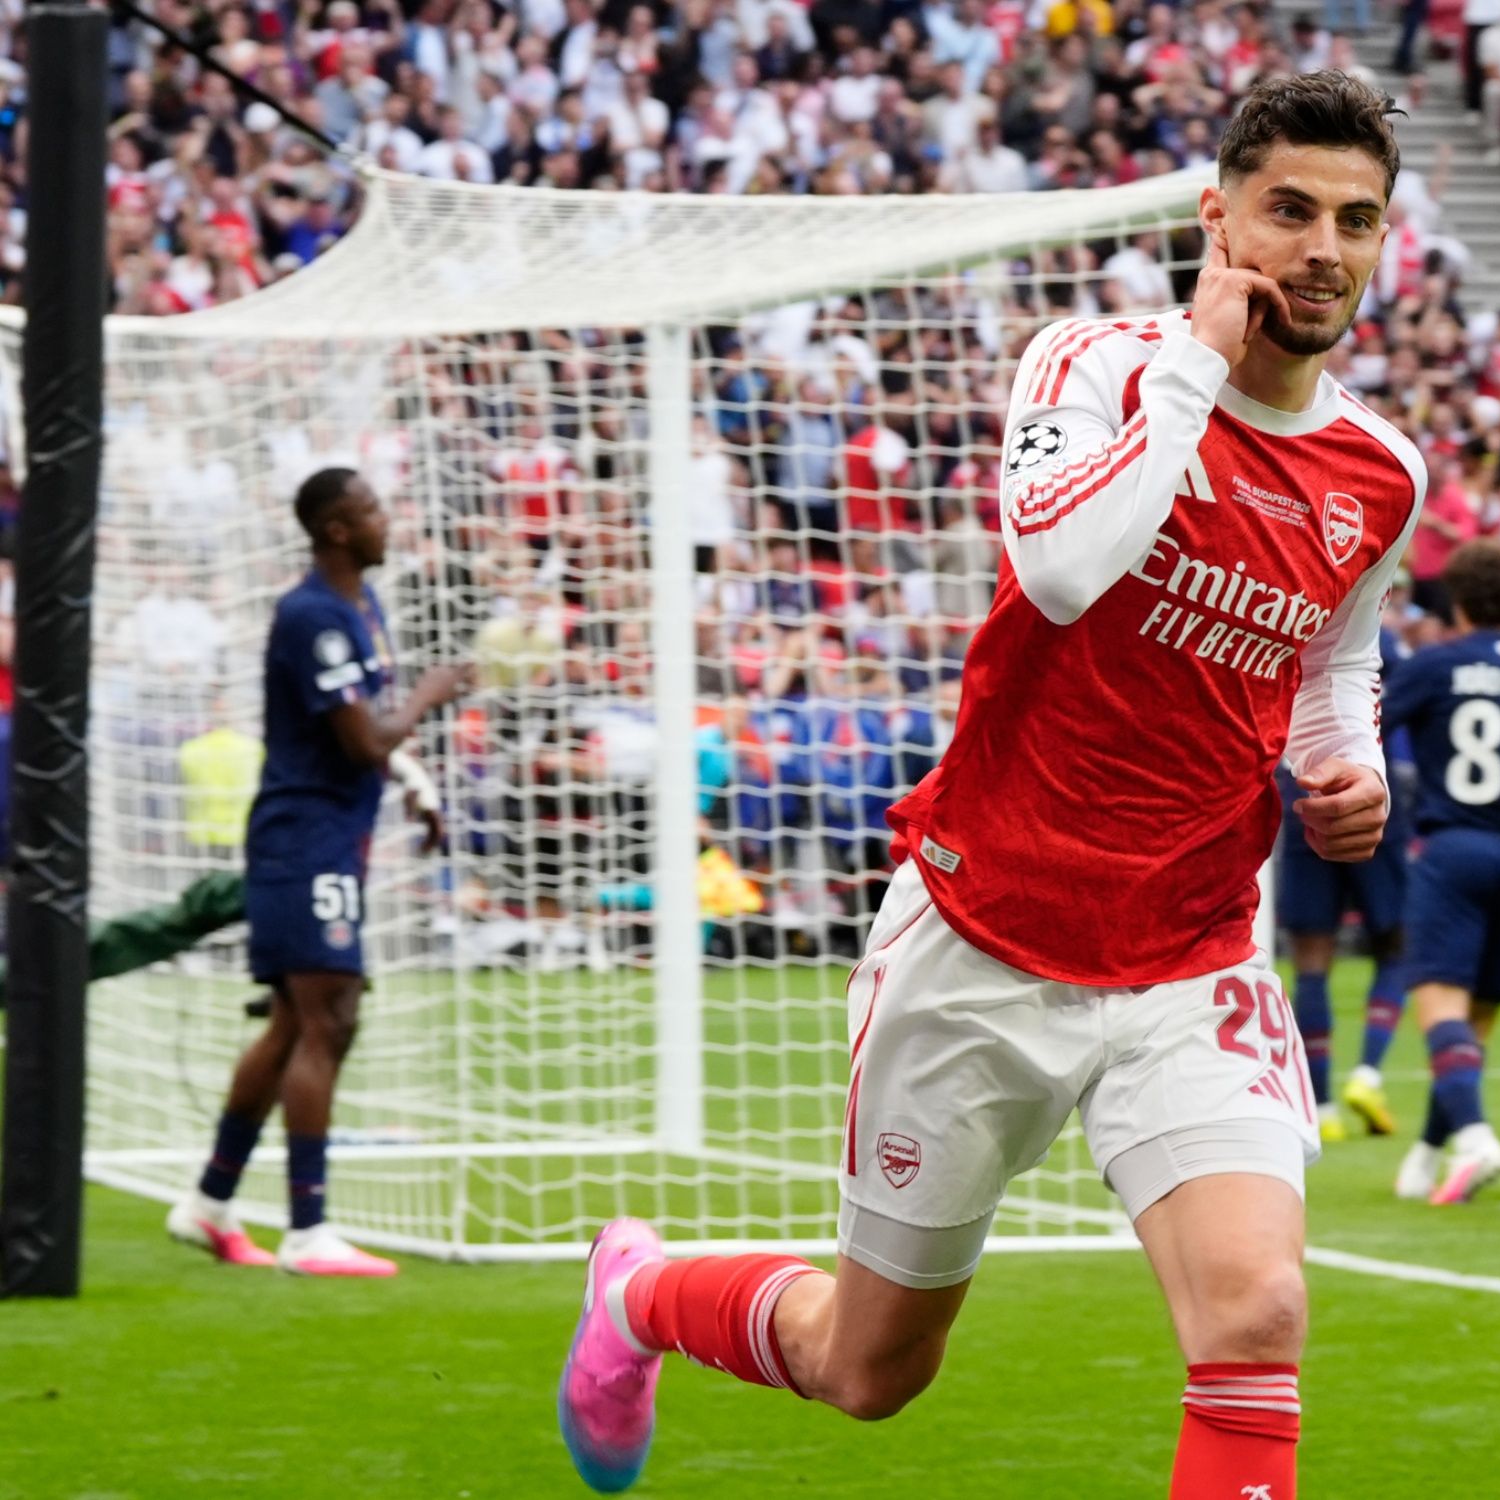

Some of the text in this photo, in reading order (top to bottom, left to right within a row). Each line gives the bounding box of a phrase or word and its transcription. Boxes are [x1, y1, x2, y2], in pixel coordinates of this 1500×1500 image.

[1232, 475, 1252, 493] FINAL
[1252, 486, 1293, 507] BUDAPEST
[1129, 531, 1331, 642] Emirates
[1138, 600, 1296, 680] FLY BETTER
[312, 873, 360, 921] 51
[1213, 976, 1288, 1071] 29
[883, 1141, 916, 1156] Arsenal
